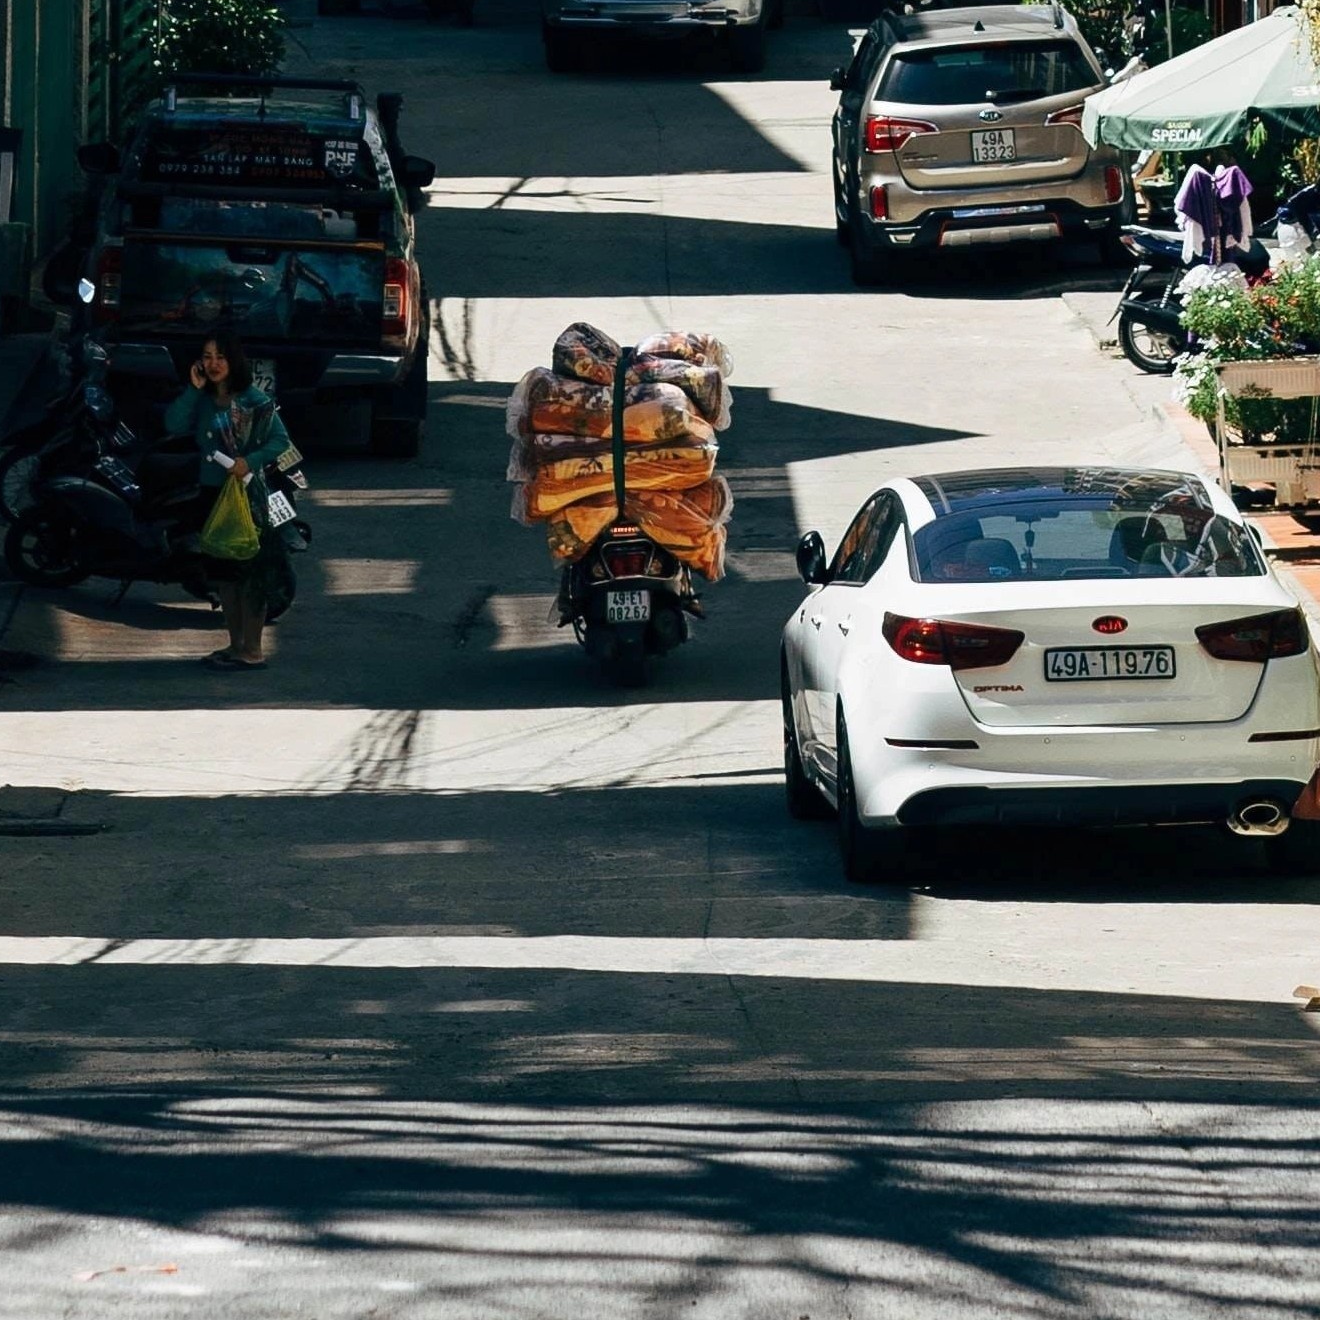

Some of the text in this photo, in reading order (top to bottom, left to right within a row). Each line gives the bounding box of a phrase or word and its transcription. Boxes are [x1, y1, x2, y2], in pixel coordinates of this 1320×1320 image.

[982, 132, 1005, 146] 49A
[1151, 128, 1203, 142] SPECIAL
[1098, 620, 1123, 631] KIA
[1051, 650, 1170, 677] 49A-119.76
[973, 684, 1025, 693] OPTIMA
